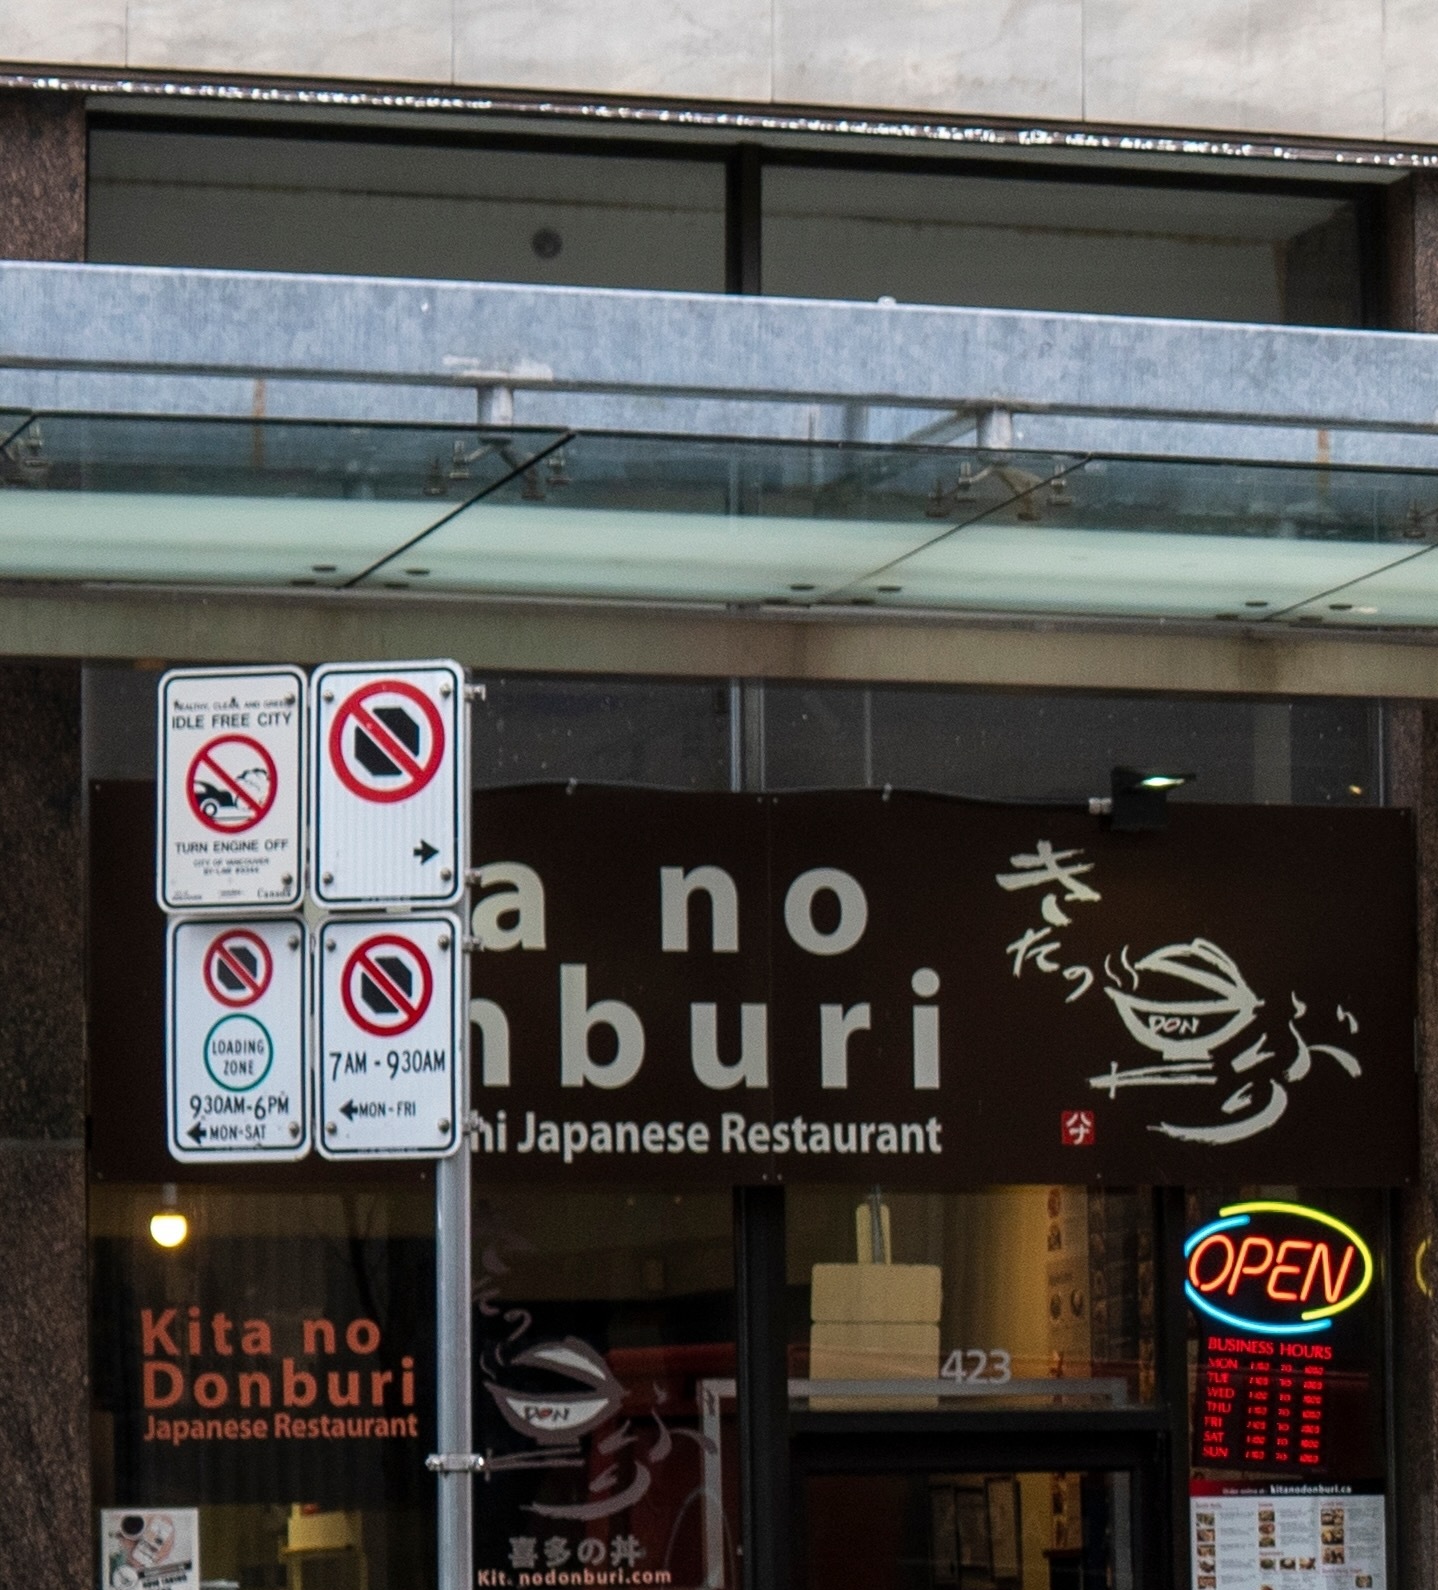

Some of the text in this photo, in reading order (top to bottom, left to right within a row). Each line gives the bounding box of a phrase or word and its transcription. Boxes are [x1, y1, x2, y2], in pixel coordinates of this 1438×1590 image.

[172, 711, 293, 730] IDLE FREE CITY
[175, 839, 289, 853] TURN ENGINE OFF
[660, 865, 868, 956] no
[1149, 1014, 1200, 1035] DON
[212, 1039, 264, 1055] LOADING
[223, 1060, 255, 1076] ZONE
[329, 1052, 367, 1081] 7AM
[387, 1050, 446, 1081] 930AM
[517, 1111, 710, 1163] Japanese
[721, 1112, 943, 1154] Restaurant
[1190, 1234, 1355, 1304] OPEN
[140, 1306, 382, 1357] Kita no
[1208, 1336, 1333, 1361] BUSINESS HOURS
[941, 1348, 1012, 1385] 423
[1208, 1357, 1239, 1370] MON
[142, 1355, 415, 1409] Donburi
[1207, 1371, 1230, 1383] TUE
[1207, 1387, 1236, 1399] WED
[1206, 1401, 1232, 1413] THU
[144, 1411, 419, 1446] Japanese Restaurant
[1204, 1416, 1223, 1428] FRI
[1204, 1430, 1225, 1442] SAT
[1203, 1446, 1229, 1458] SUN
